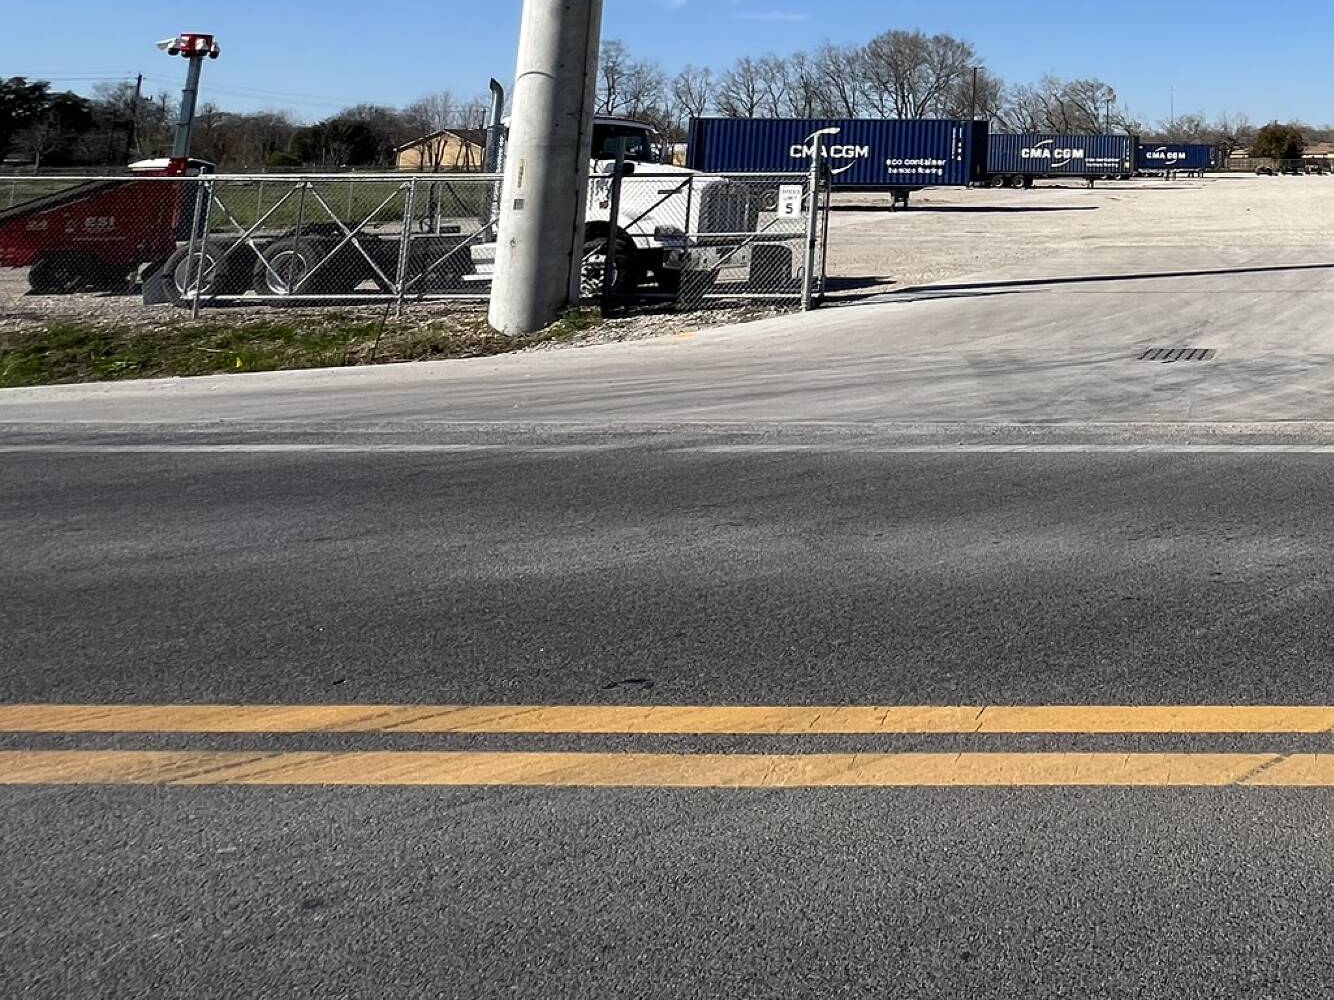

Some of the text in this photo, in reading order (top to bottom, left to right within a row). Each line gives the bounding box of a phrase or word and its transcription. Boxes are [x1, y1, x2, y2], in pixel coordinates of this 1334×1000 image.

[790, 145, 869, 158] CMA CGM
[1021, 148, 1084, 158] CMA CGM
[904, 157, 947, 166] container
[785, 202, 794, 214] 5
